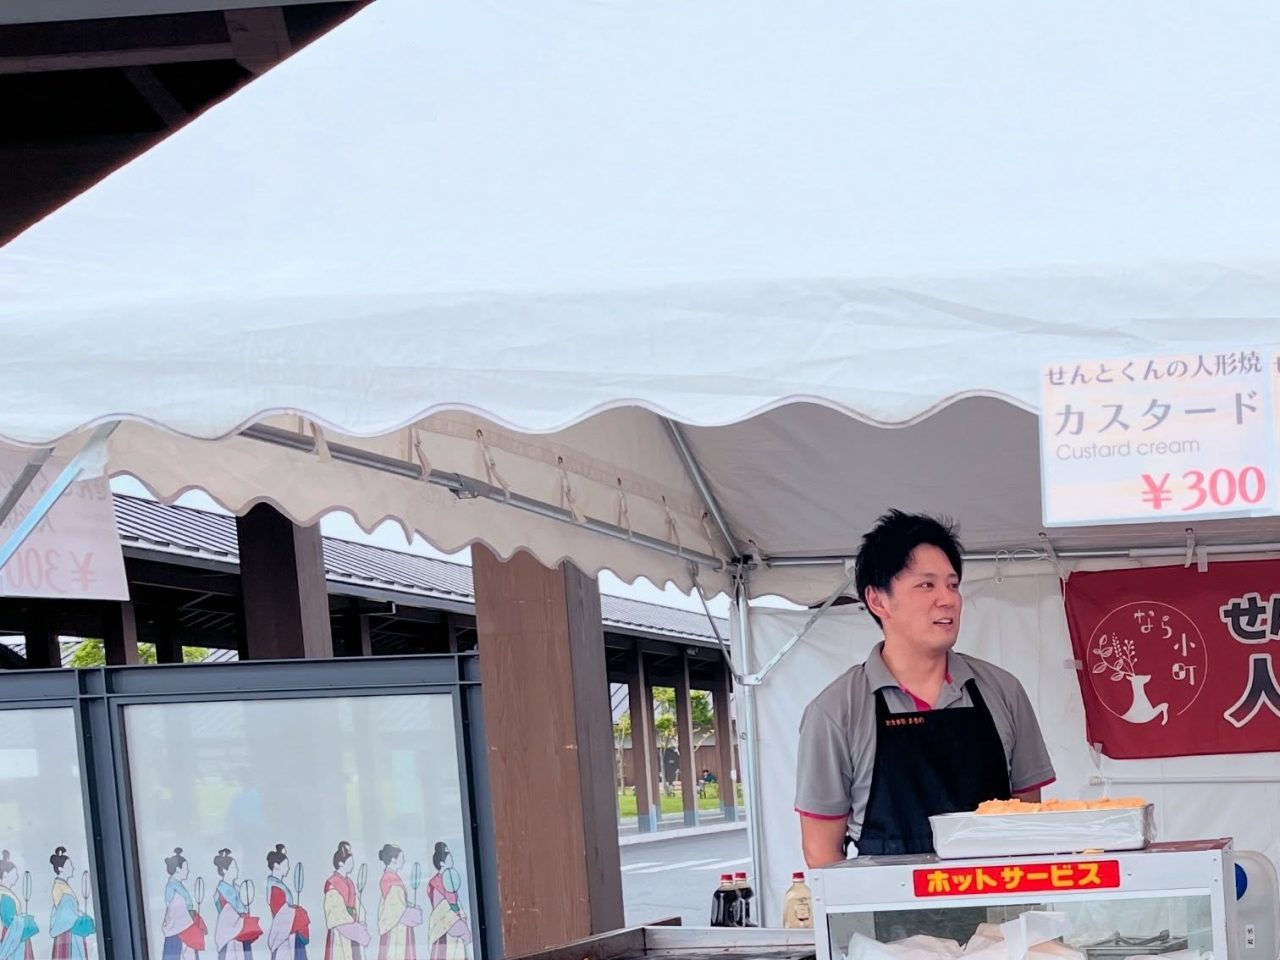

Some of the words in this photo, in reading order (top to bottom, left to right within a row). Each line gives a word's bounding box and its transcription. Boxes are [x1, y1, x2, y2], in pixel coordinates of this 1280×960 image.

[1045, 351, 1262, 386] せんとくんの人形焼
[1055, 390, 1259, 436] カスタード
[1056, 440, 1131, 461] Custard
[1137, 437, 1200, 455] cream
[1141, 466, 1266, 510] ¥300
[927, 862, 1102, 893] ホットサービス
